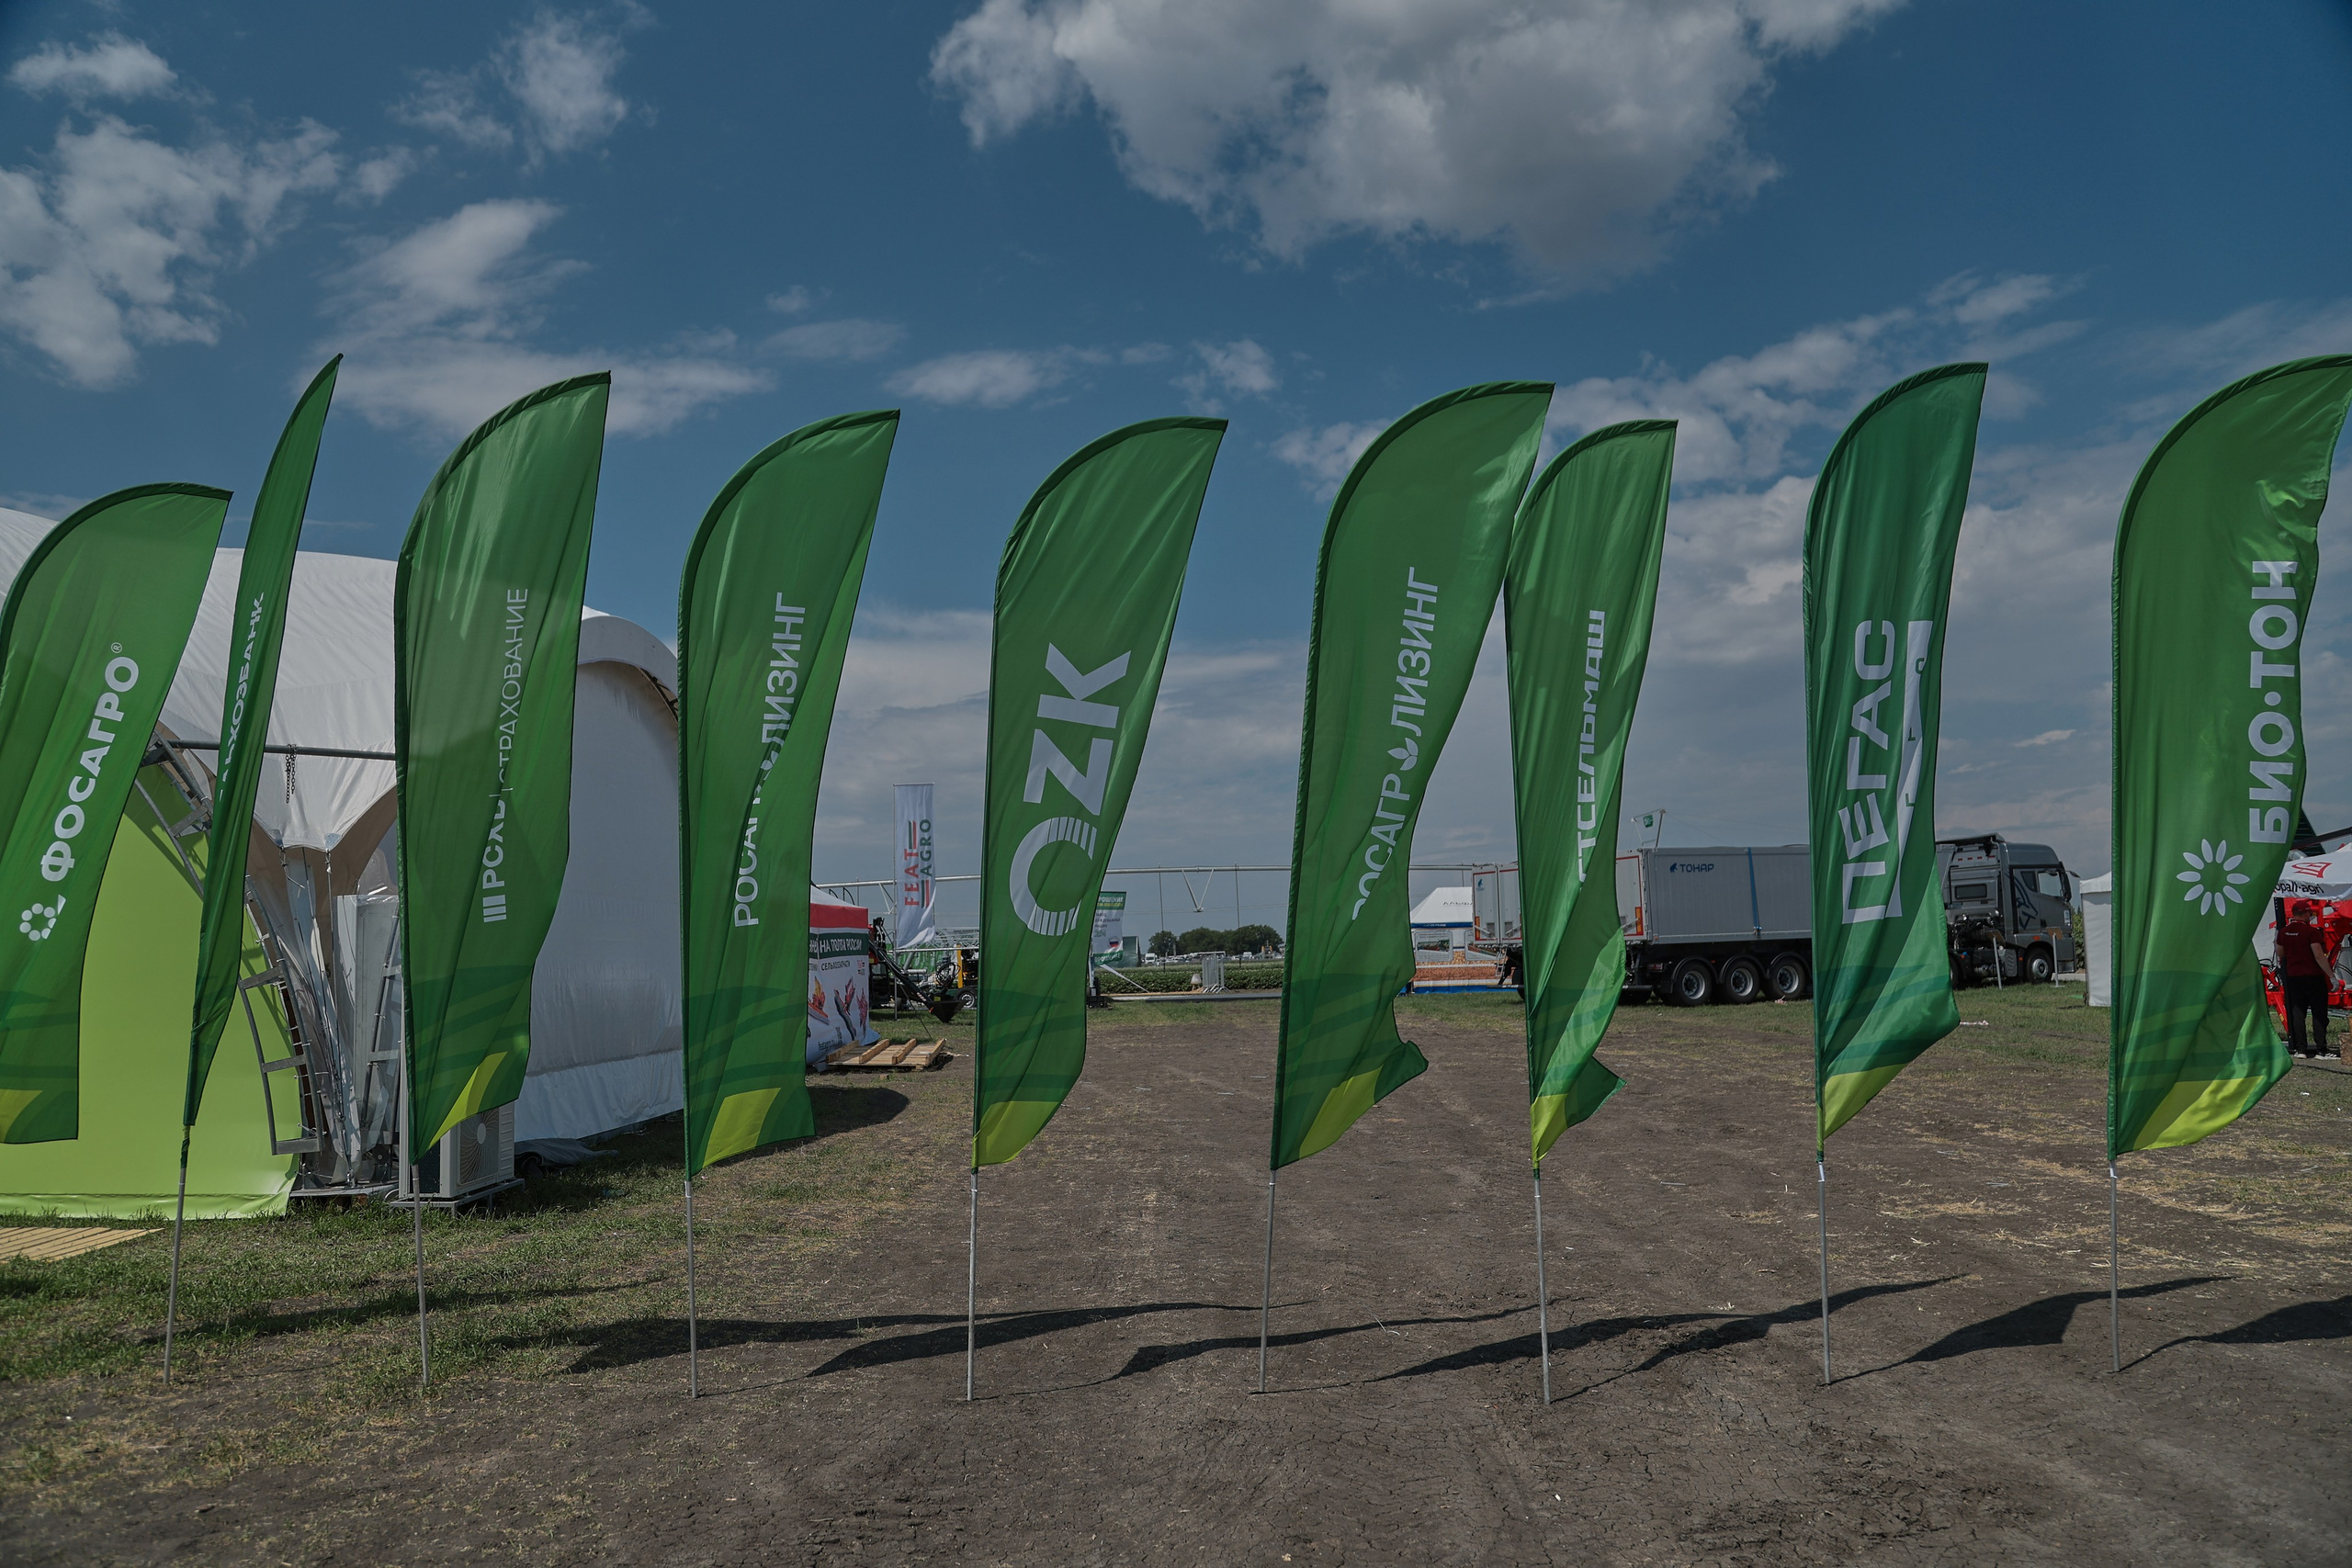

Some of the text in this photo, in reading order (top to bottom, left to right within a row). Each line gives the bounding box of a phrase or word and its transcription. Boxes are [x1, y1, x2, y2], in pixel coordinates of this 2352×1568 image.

[1838, 620, 1894, 924] ПЕГАС
[920, 818, 933, 877] AGRO
[1679, 863, 1714, 873] ТОНАР
[904, 849, 919, 907] FEAT
[820, 940, 831, 953] НА
